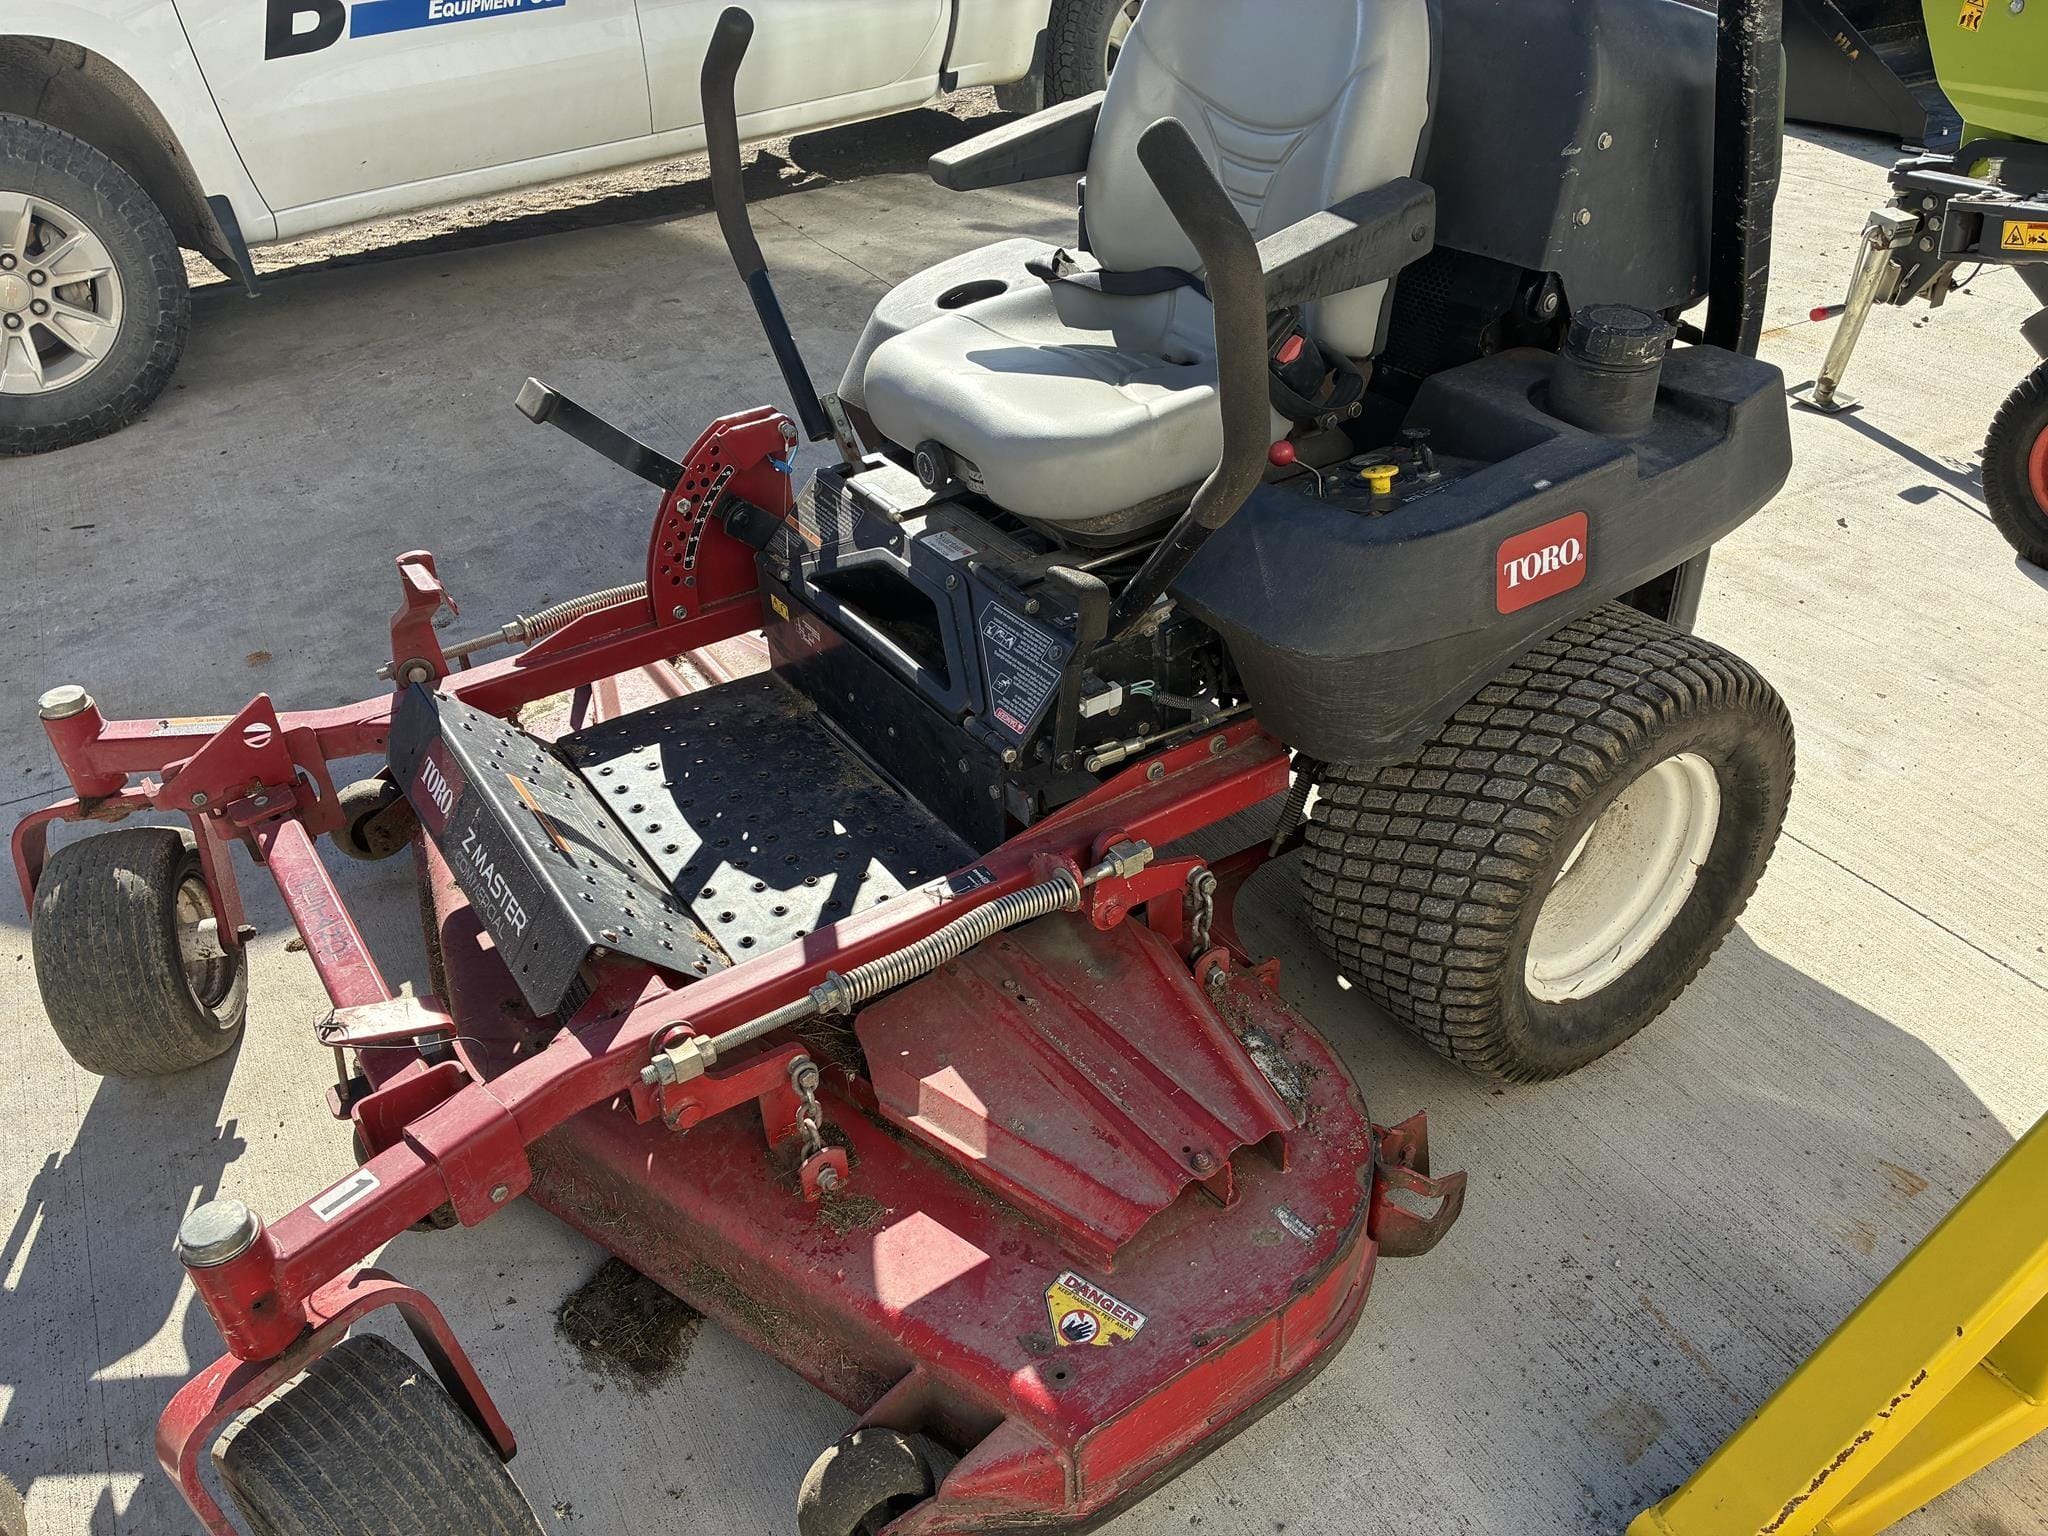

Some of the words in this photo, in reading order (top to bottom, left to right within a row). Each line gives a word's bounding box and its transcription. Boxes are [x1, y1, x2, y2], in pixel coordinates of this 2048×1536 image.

[471, 843, 529, 938] MASTER
[1057, 1286, 1073, 1297] KEEP
[1115, 1319, 1133, 1333] AWAY
[1064, 1275, 1138, 1327] DANGER
